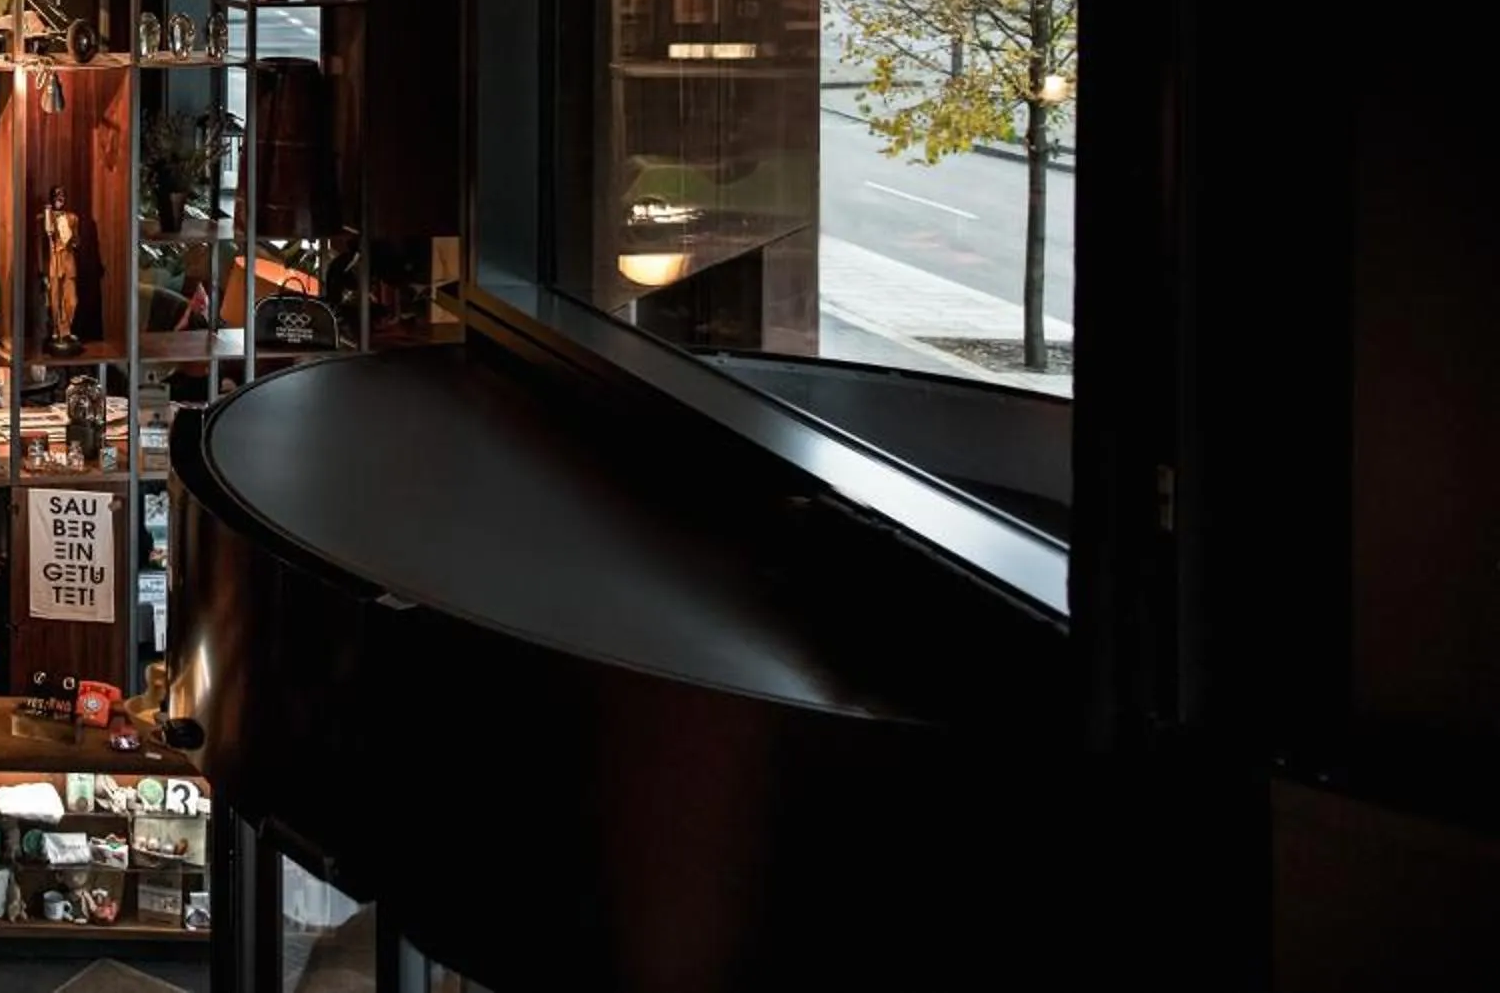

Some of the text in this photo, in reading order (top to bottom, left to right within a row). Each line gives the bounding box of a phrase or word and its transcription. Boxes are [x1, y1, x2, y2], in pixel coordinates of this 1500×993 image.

[49, 496, 97, 516] SAU
[53, 518, 96, 540] BER
[54, 541, 93, 561] EIN
[52, 585, 95, 606] TET!
